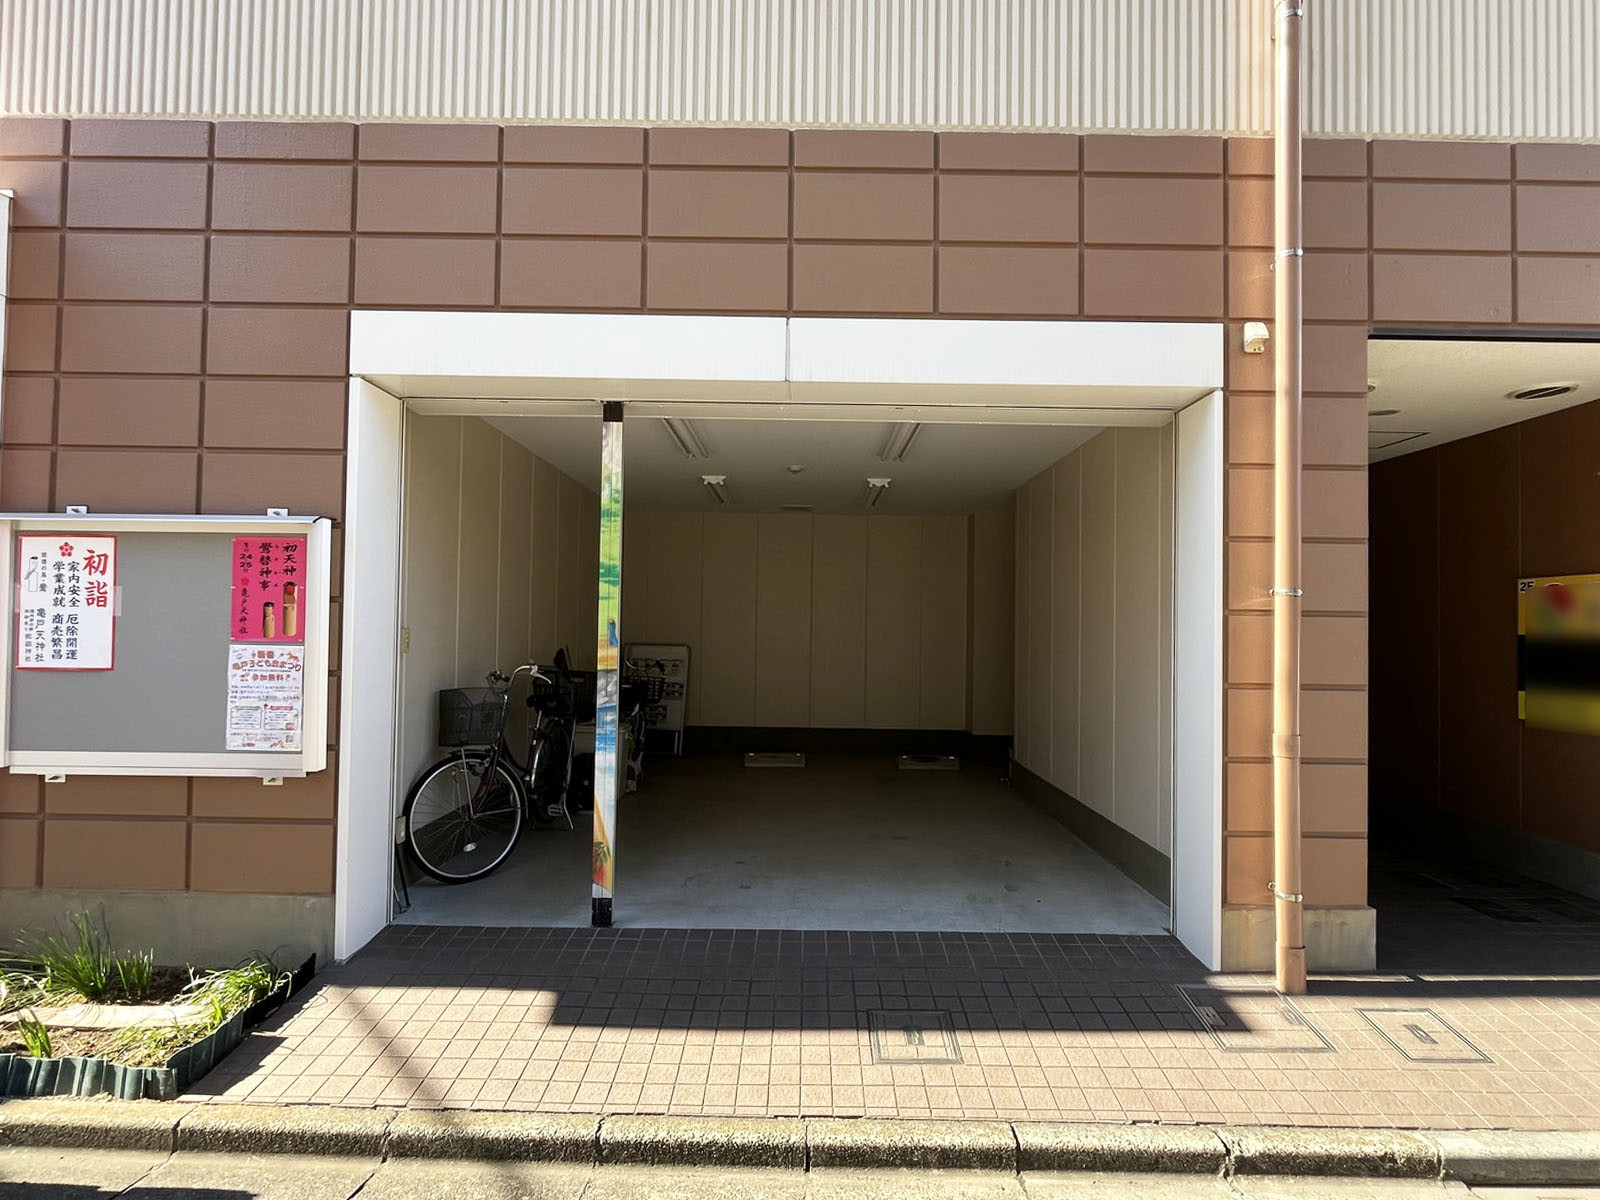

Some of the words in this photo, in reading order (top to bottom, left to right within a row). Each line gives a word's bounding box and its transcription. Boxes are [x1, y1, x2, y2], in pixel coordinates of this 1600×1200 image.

[82, 548, 109, 608] 初詣
[282, 542, 298, 576] 初天神
[52, 561, 66, 608] 学業成就
[67, 561, 80, 608] 家内安全
[35, 608, 47, 662] 亀戸天神社
[65, 613, 79, 660] 厄除開運
